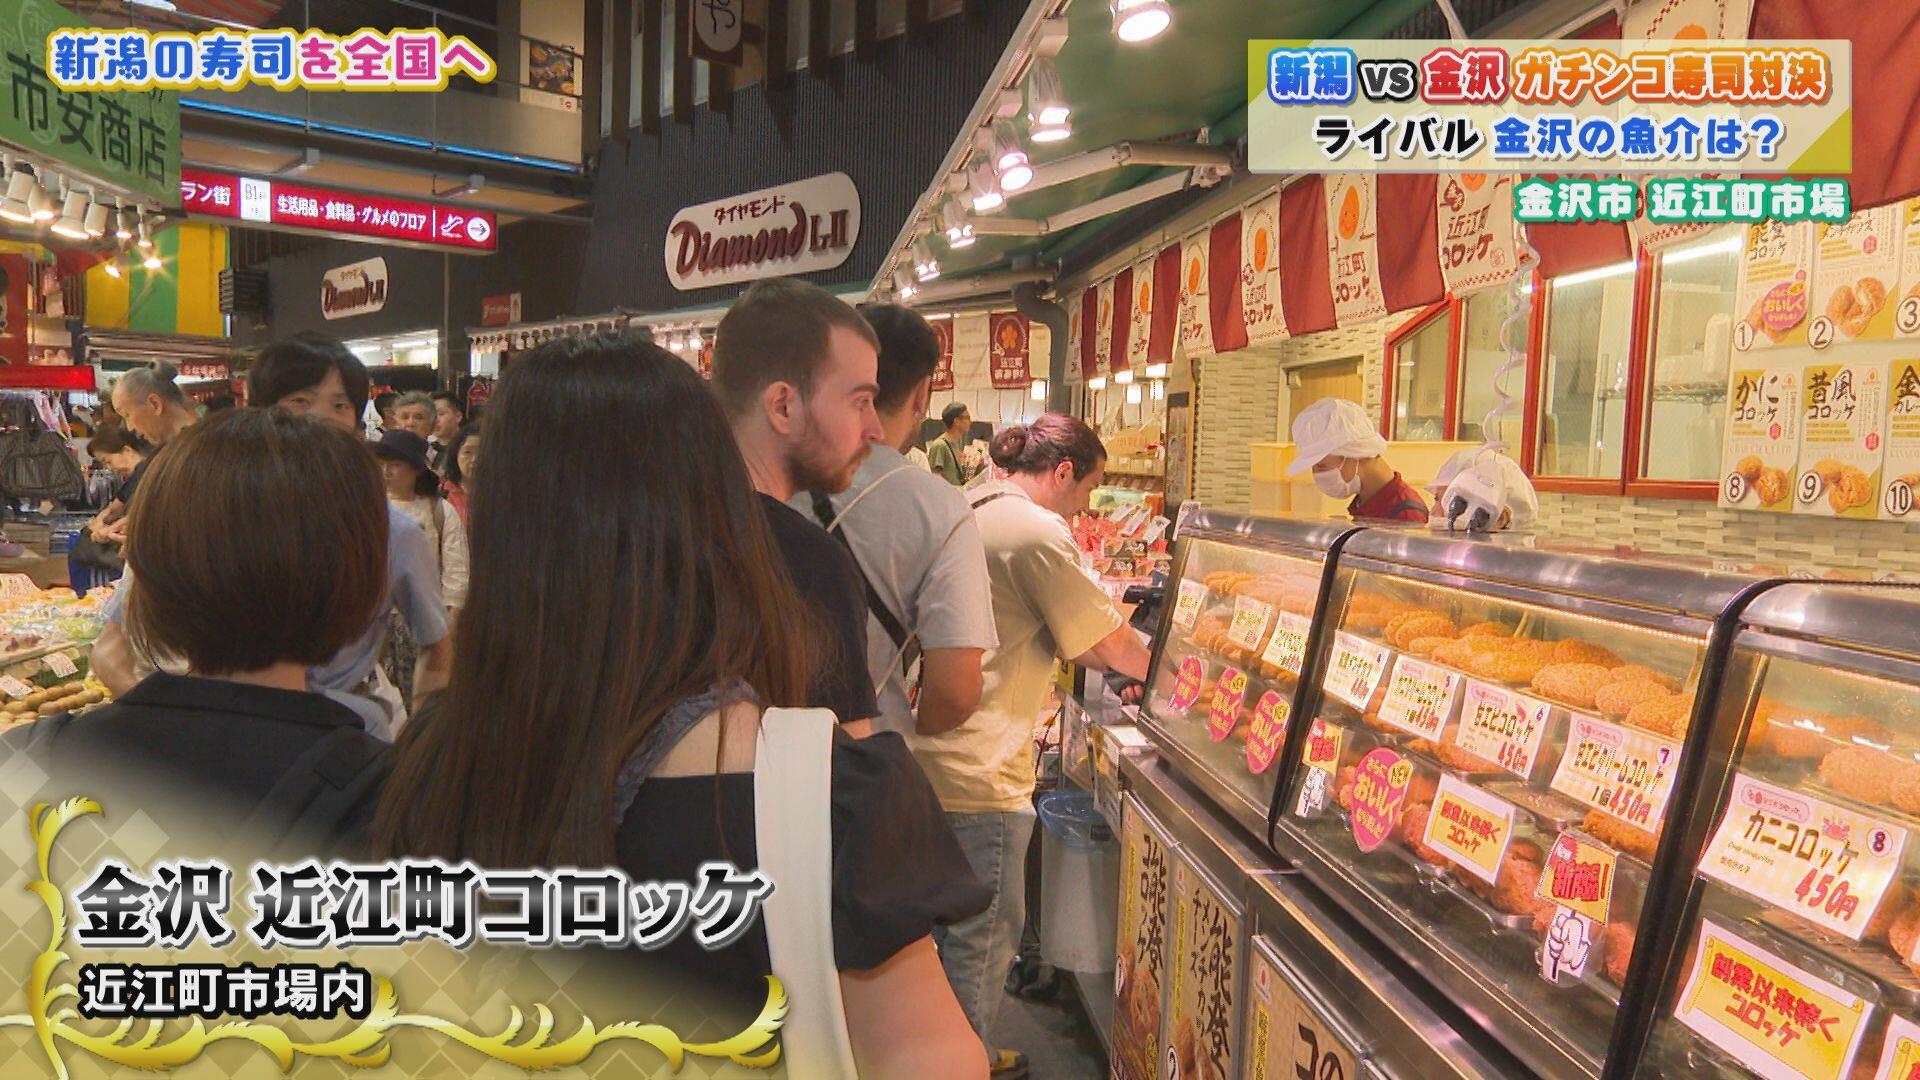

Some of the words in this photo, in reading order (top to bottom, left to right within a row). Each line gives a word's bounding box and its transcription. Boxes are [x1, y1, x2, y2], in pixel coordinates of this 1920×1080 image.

[180, 181, 231, 206] ラン街
[714, 195, 787, 226] ダイヤモンド
[670, 201, 807, 276] Diamond
[1748, 242, 1787, 261] コロッケ
[1336, 250, 1367, 278] 江町
[1763, 296, 1805, 313] おいしく
[1735, 374, 1780, 405] かに
[1806, 368, 1858, 405] 昔風
[1734, 402, 1779, 423] コロッケ
[1807, 403, 1857, 421] コロッケ
[1890, 484, 1909, 513] 10
[1473, 701, 1535, 744] 甘エビコロッケ
[1497, 741, 1528, 774] 450円
[1353, 773, 1403, 825] おいしく
[1446, 823, 1482, 854] コロッケ
[1744, 810, 1860, 875] カニコロッケ
[1793, 867, 1860, 922] 450円
[1147, 840, 1167, 990] 能登
[1195, 897, 1211, 1038] メンチカツ
[1206, 906, 1233, 1080] 能登
[1710, 951, 1841, 1043] 創業以来続く
[1724, 992, 1802, 1048] コロッケ
